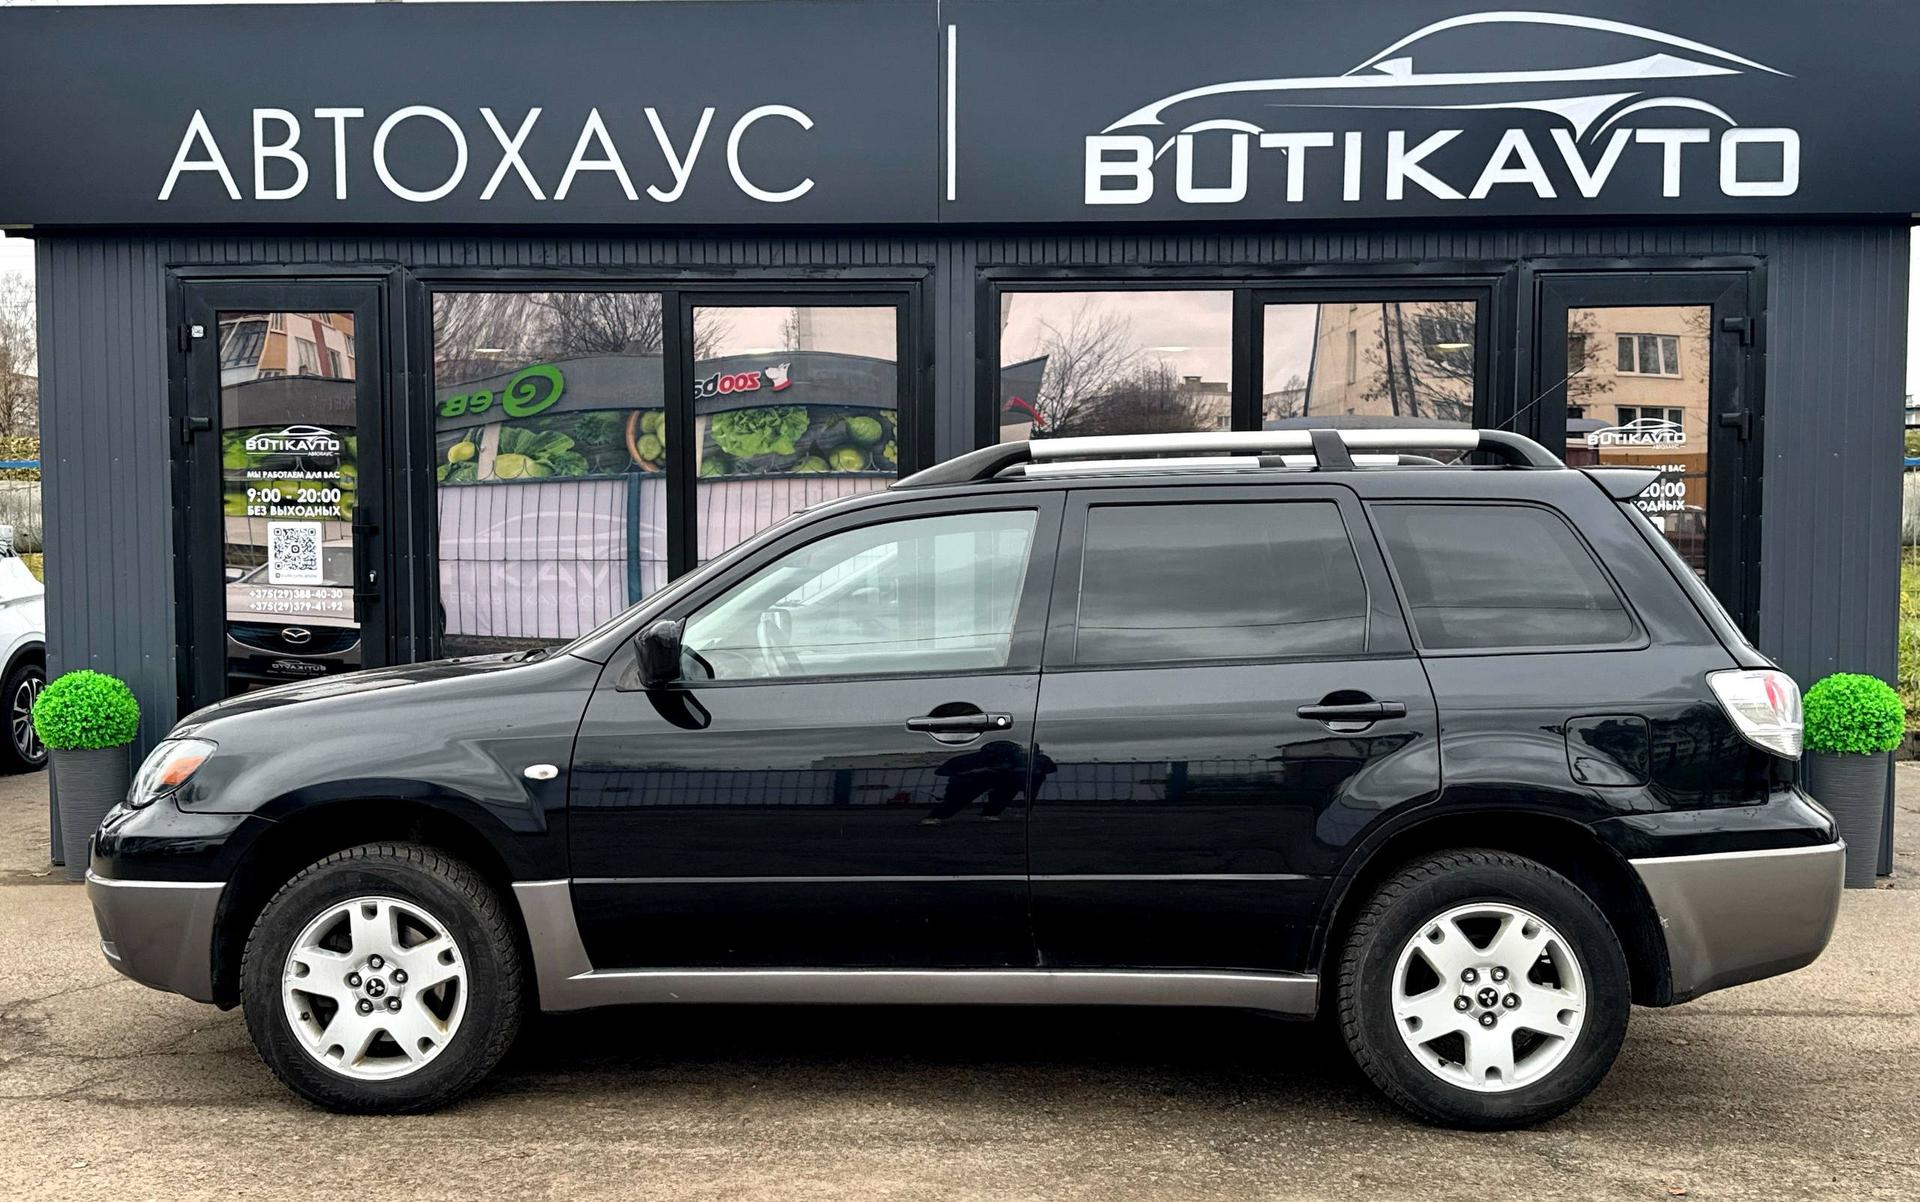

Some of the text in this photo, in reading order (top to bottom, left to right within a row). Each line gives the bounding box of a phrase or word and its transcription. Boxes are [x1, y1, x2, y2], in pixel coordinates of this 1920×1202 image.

[157, 105, 815, 203] АВТОХАУС
[1084, 127, 1800, 205] BUTIKAVTO
[245, 439, 340, 451] BUTIKAVTO
[1587, 433, 1687, 446] BUTIKAVTO
[1668, 464, 1686, 472] ВАС
[246, 471, 340, 480] МЫ РАБОТАЕМ ДЛЯ ВАС
[246, 488, 281, 503] 9:00
[296, 488, 341, 503] 20:00
[247, 505, 341, 517] БЕЗ ВЫХОДНЫХ
[1633, 500, 1686, 512] ОДНЫХ
[249, 589, 344, 601] +375(29)388-40-30
[249, 601, 344, 613] +375(29)379-41-92
